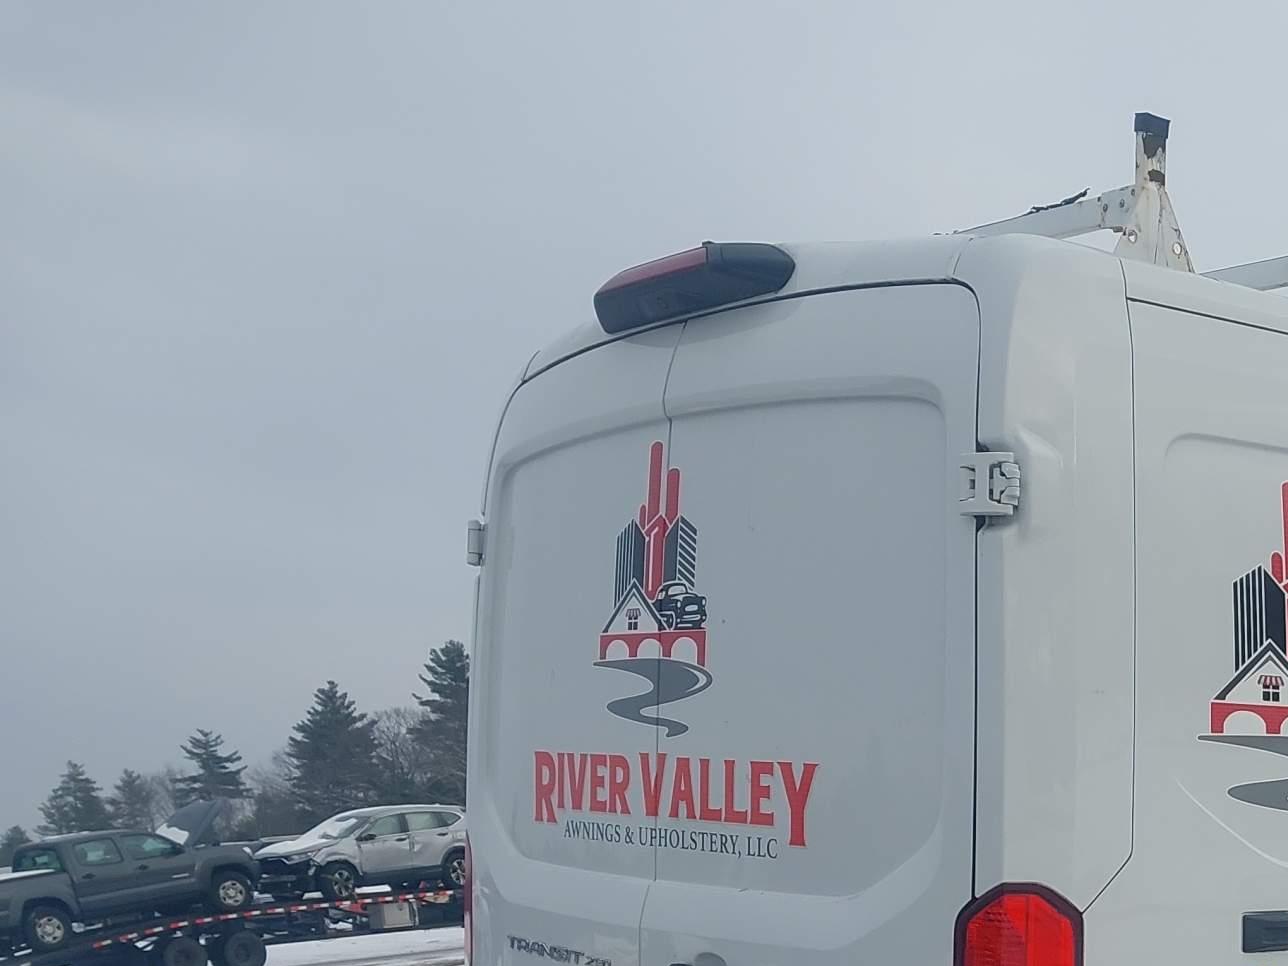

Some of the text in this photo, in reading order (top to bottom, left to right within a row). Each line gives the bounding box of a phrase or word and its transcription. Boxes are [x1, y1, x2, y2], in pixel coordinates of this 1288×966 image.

[533, 750, 820, 847] RIVER VALLEY
[563, 818, 778, 860] AWNINGS & UPHOLSTERY, LLC
[507, 935, 584, 965] TRANSIT
